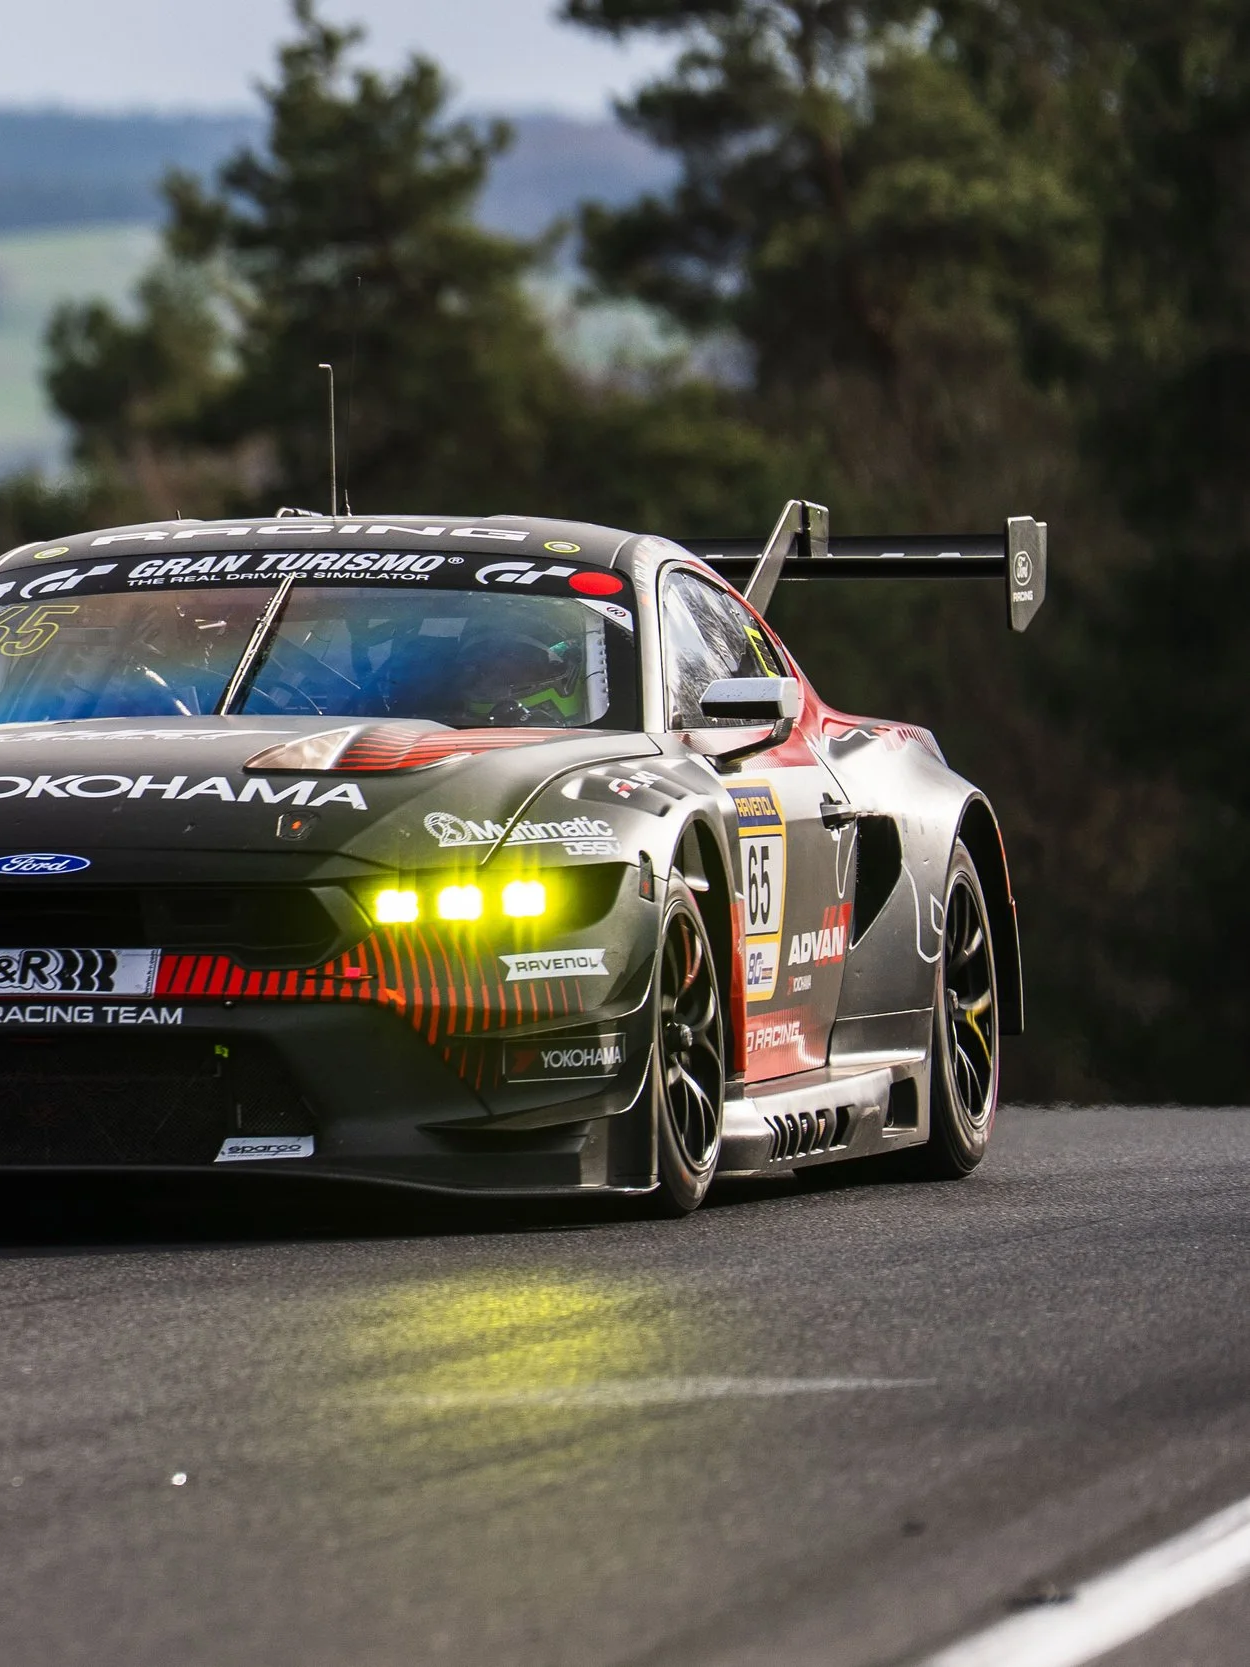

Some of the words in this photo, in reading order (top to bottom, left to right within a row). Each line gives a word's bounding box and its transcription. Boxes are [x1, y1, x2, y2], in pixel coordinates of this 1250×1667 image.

[91, 525, 530, 546] RACING
[128, 554, 252, 579] GRAN
[127, 578, 164, 587] THE
[170, 573, 221, 583] REAL
[226, 571, 307, 581] DRIVING
[313, 571, 430, 581] SIMULATOR
[465, 816, 613, 841] Multimatic
[1, 855, 69, 874] Ford
[748, 844, 770, 926] 65
[788, 926, 845, 966] ADVAN
[515, 957, 598, 972] RAVENOL
[102, 1007, 183, 1025] TEAM
[755, 1022, 801, 1050] RACING
[541, 1047, 622, 1068] YOKOHAMA
